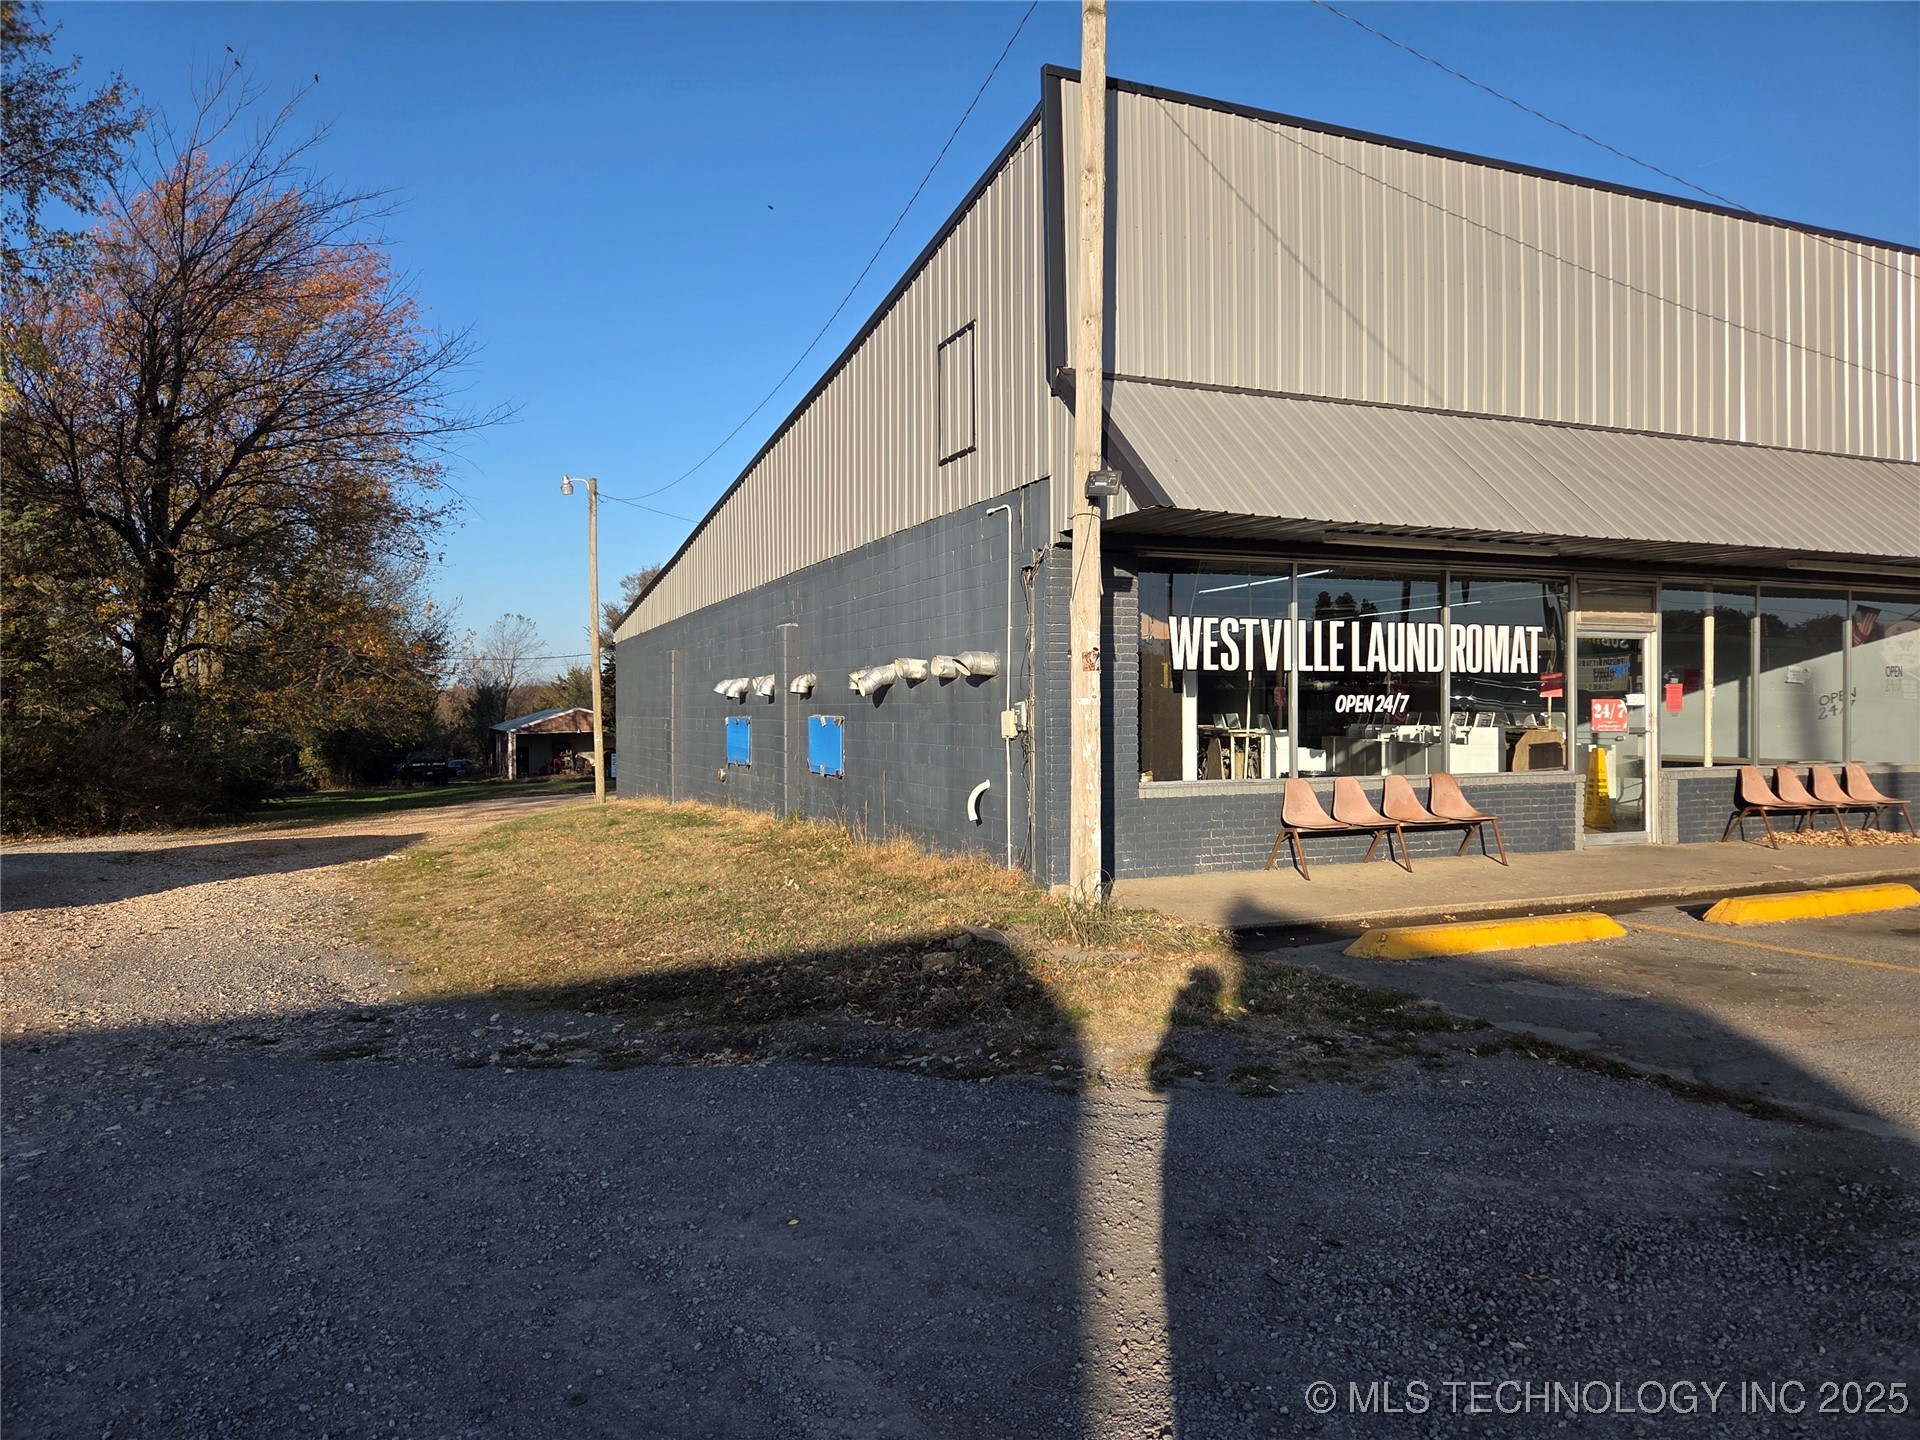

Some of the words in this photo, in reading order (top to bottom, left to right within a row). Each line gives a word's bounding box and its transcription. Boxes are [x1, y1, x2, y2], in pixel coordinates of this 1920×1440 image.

[1168, 615, 1345, 672] WESTVILLE
[1351, 621, 1543, 674] LAUNDROMAT
[1885, 665, 1903, 678] OPEN
[1335, 694, 1374, 714] OPEN
[1374, 692, 1410, 715] 24/7
[1593, 703, 1626, 719] 24/7
